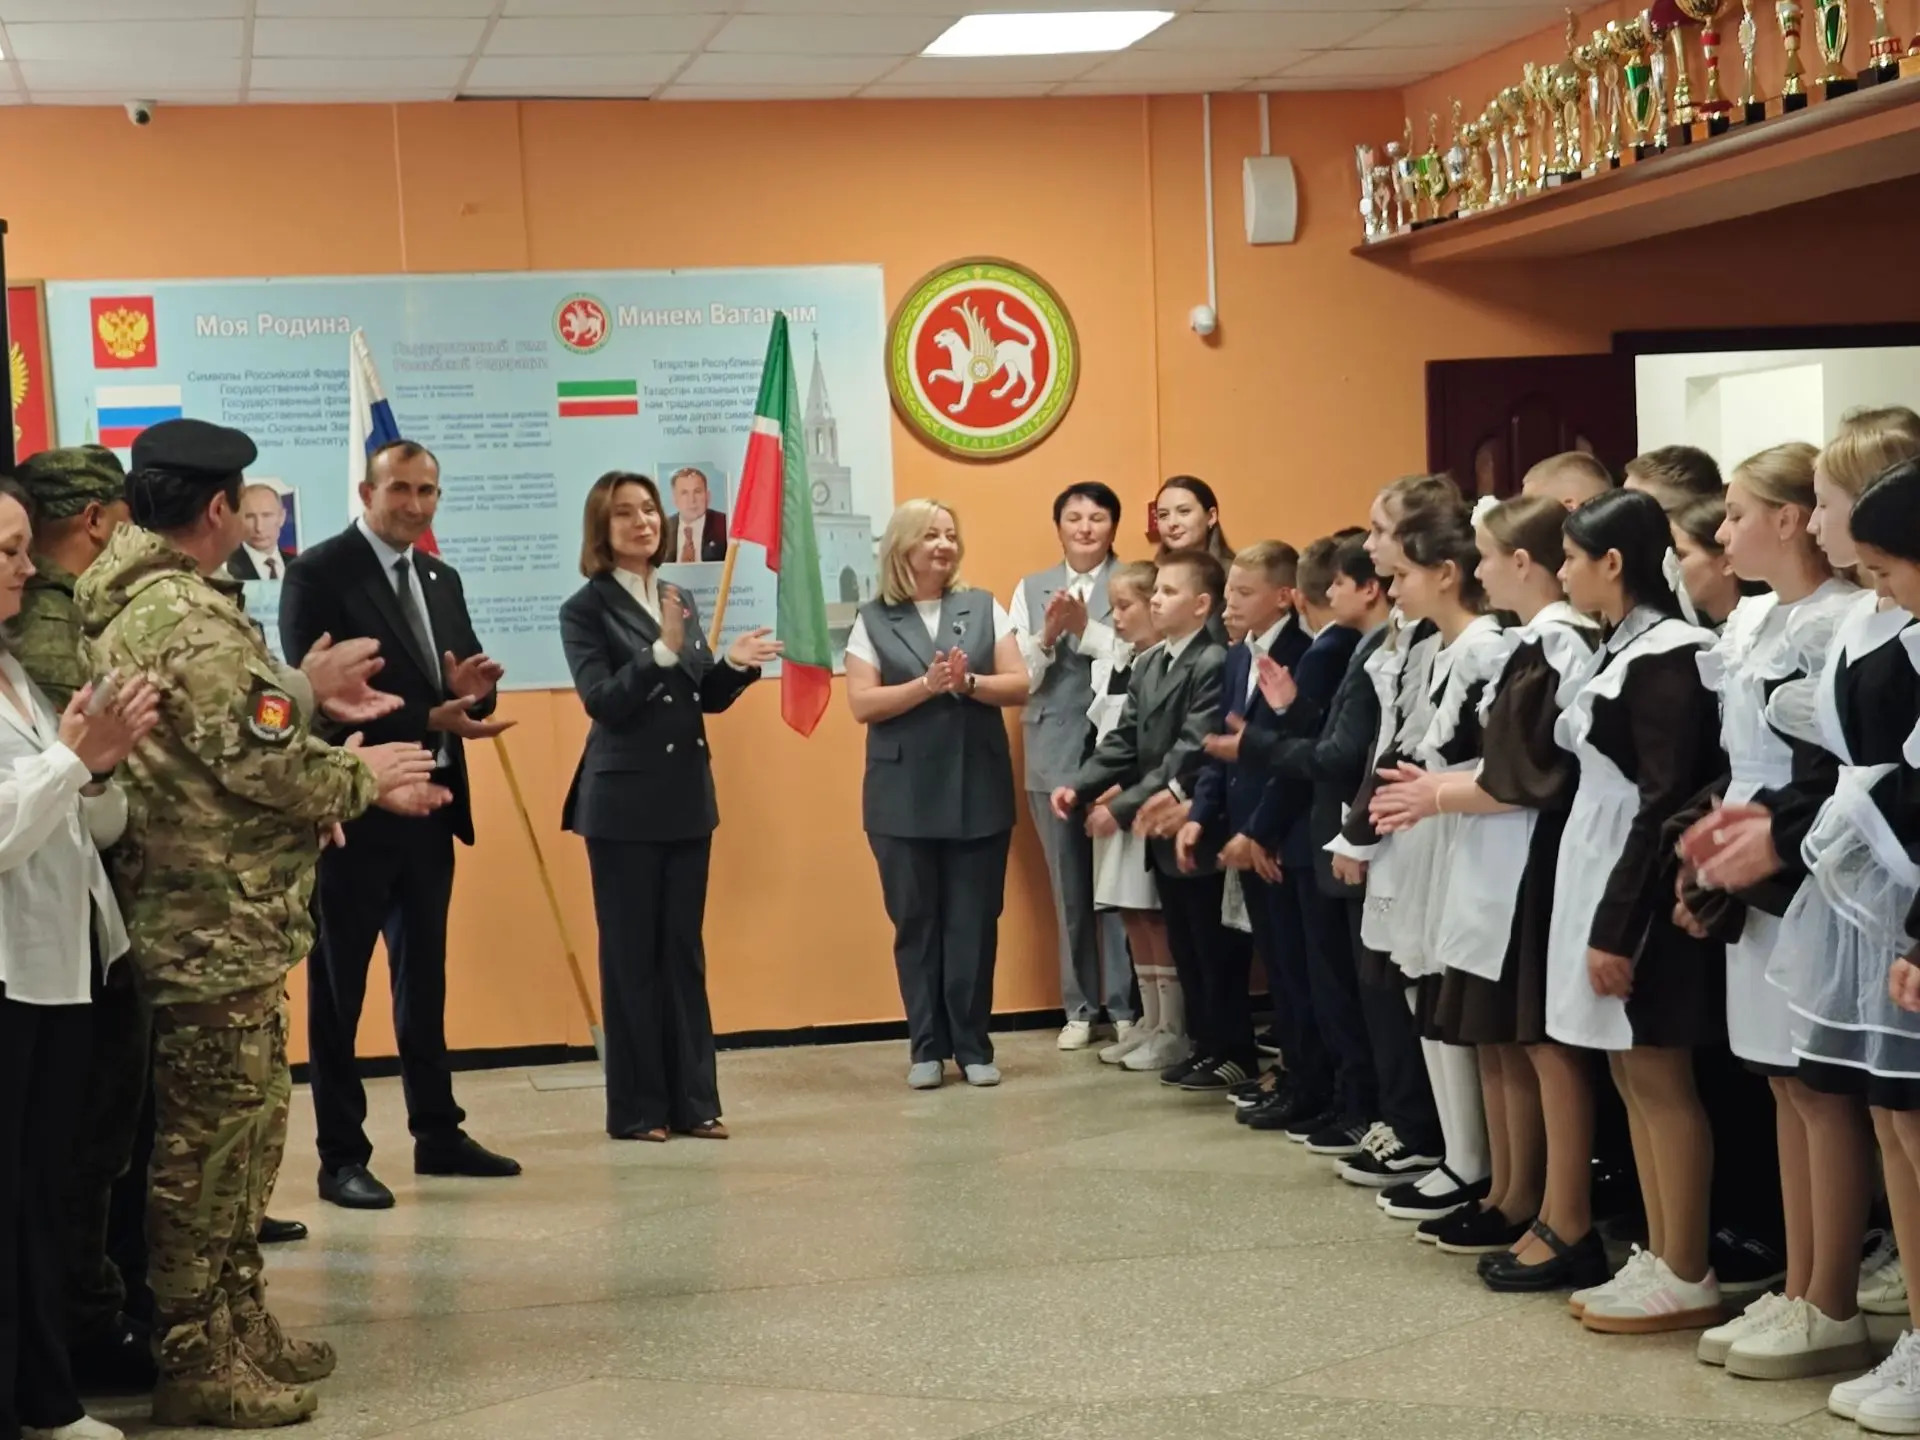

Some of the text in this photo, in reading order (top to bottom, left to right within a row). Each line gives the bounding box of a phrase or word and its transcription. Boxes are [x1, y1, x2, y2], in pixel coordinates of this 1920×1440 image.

[617, 304, 702, 327] Минем
[195, 311, 350, 339] Моя Родина
[701, 357, 762, 369] Республикас
[187, 368, 349, 382] Символы Российской Федер
[220, 382, 319, 395] Государственный
[221, 398, 321, 409] Государственный
[222, 411, 322, 423] Государственный
[267, 424, 327, 434] Основным
[940, 422, 1033, 448] ТАТАРСТАН
[294, 437, 349, 448] Конститу
